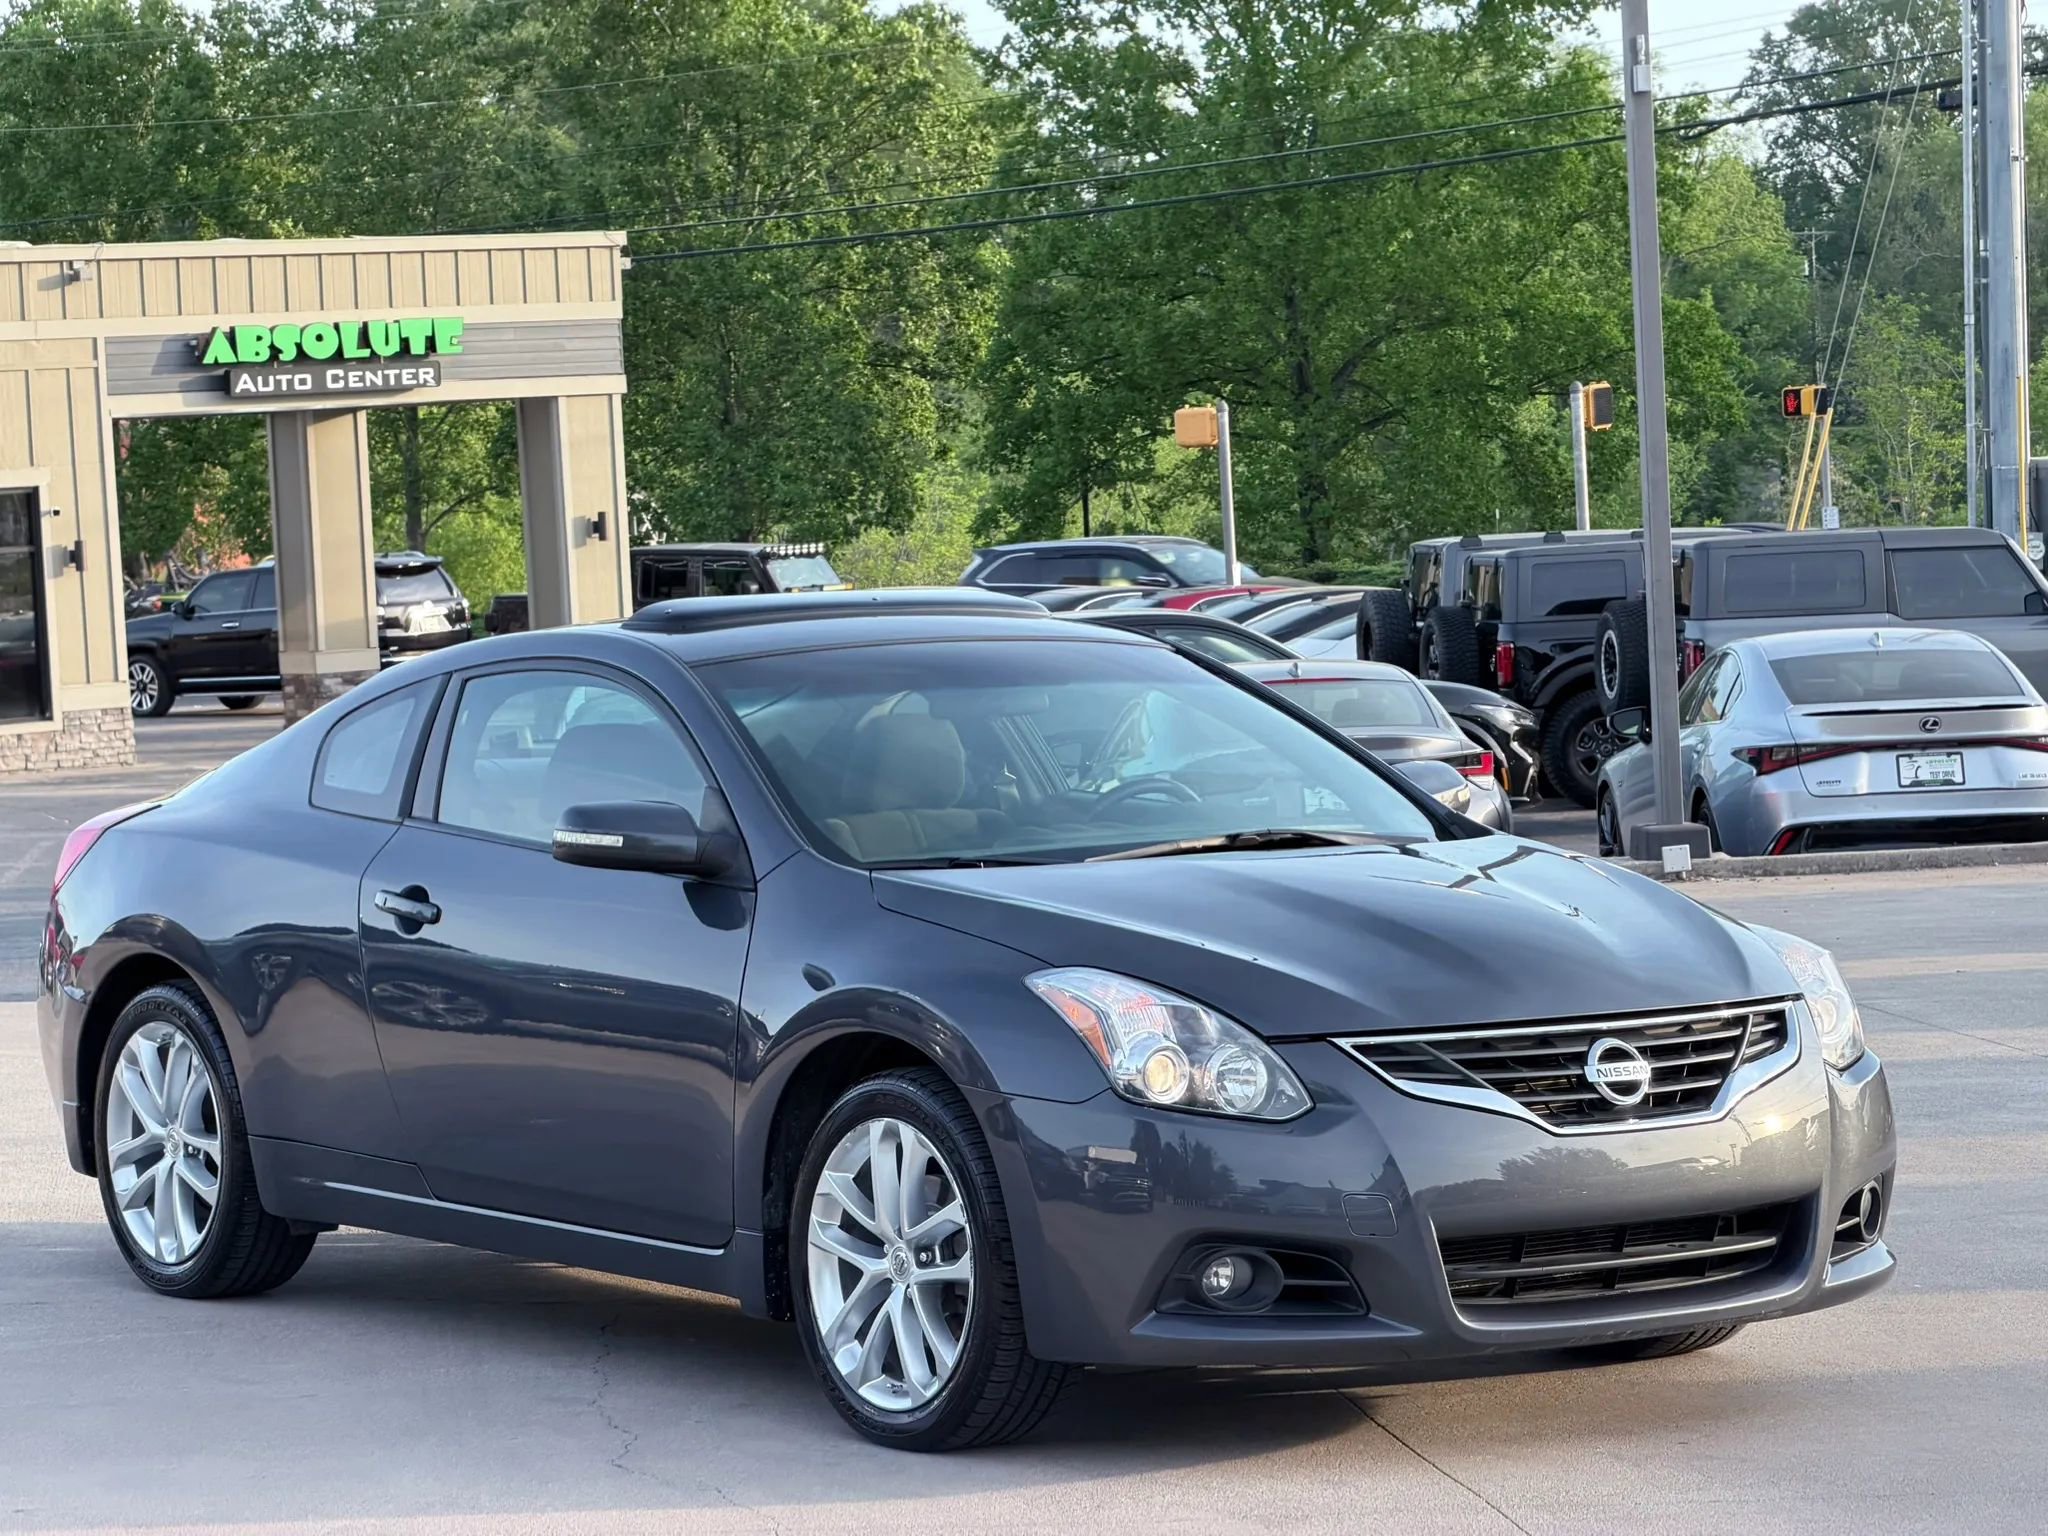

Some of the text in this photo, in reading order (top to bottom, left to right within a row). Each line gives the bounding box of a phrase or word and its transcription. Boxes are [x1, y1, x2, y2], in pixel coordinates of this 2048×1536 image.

[203, 317, 464, 364] ABSOLUTE
[234, 366, 436, 393] AUTO CENTER
[1596, 1065, 1648, 1078] NISSAN
